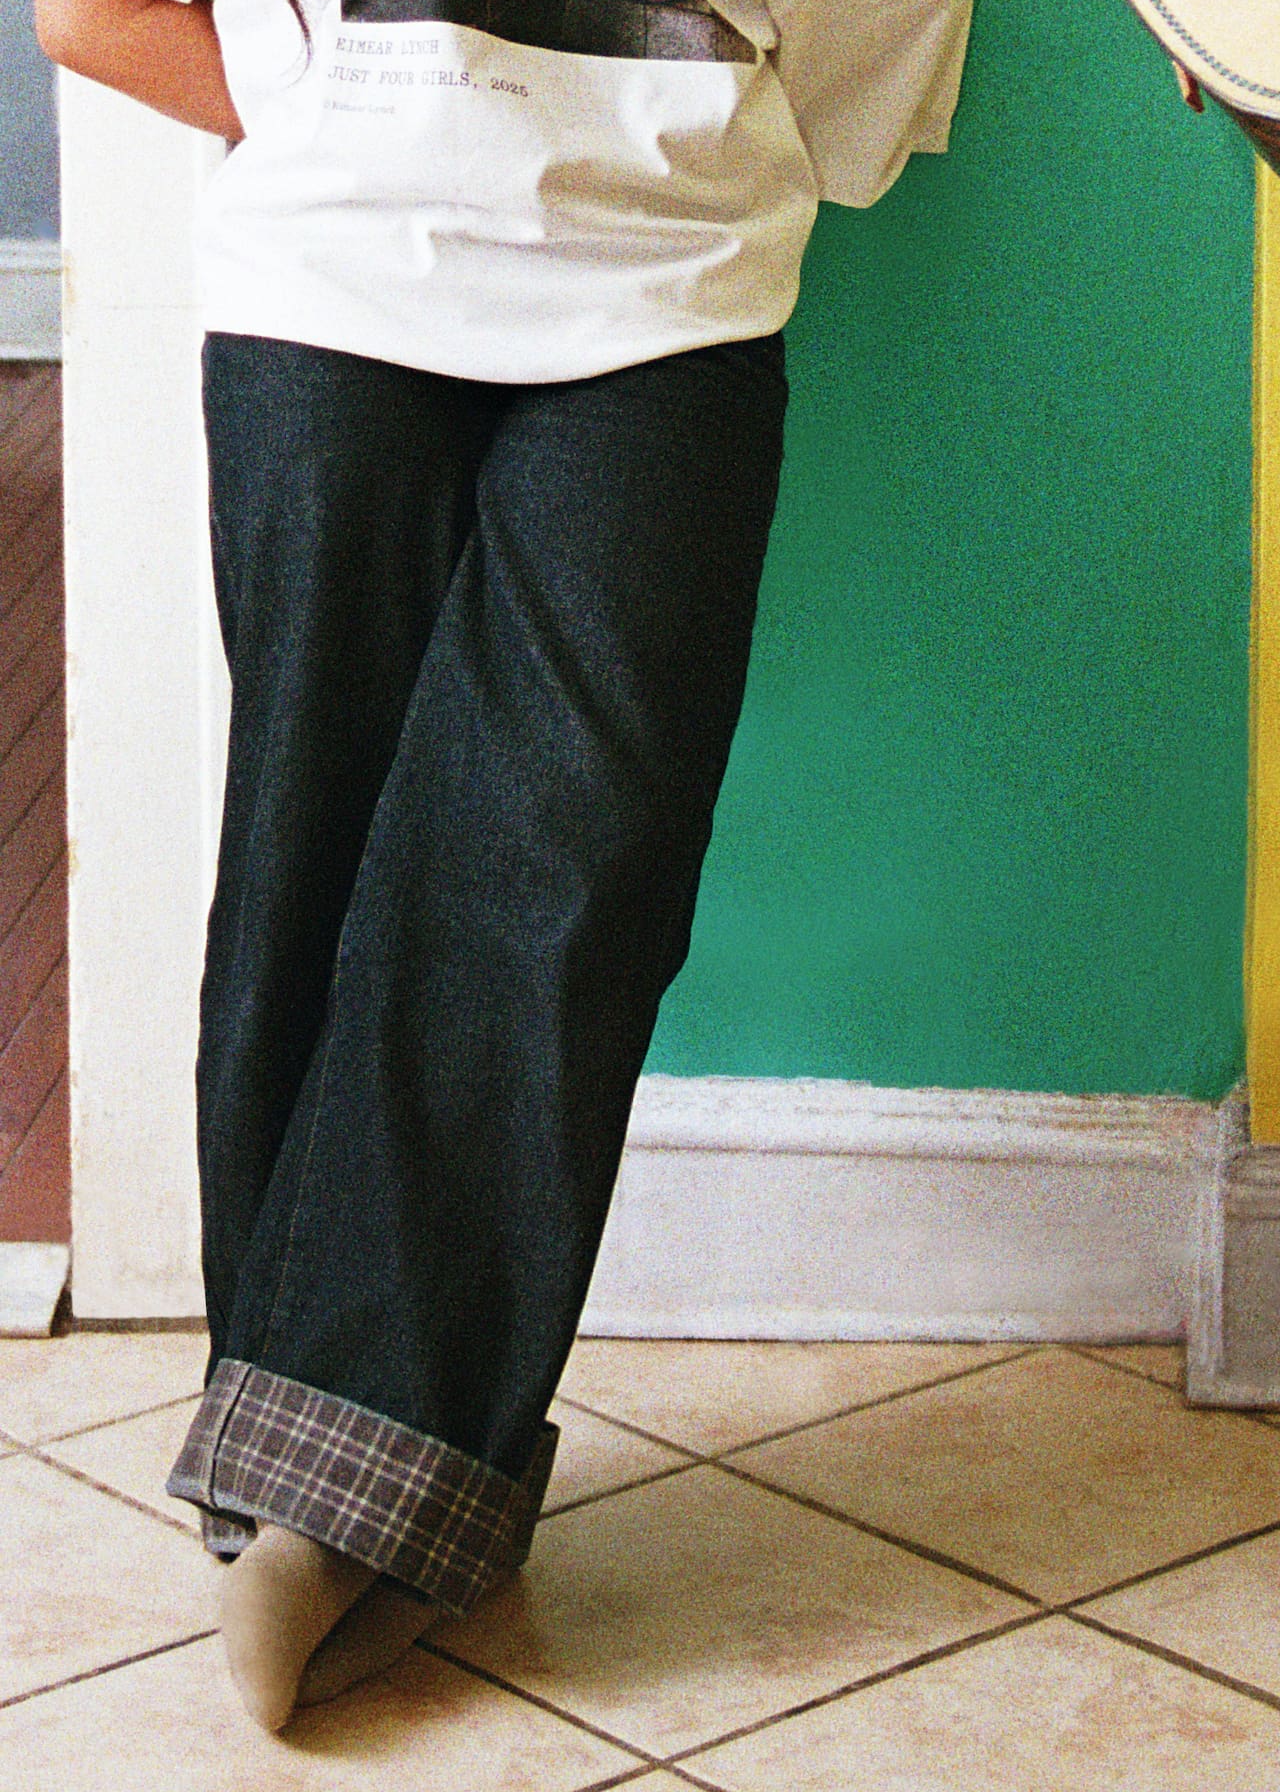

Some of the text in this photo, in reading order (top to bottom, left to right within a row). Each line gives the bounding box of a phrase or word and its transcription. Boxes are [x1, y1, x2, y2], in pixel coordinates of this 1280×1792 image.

[336, 37, 393, 55] EIMEAR
[328, 65, 370, 84] JUST
[379, 71, 414, 85] FOUR
